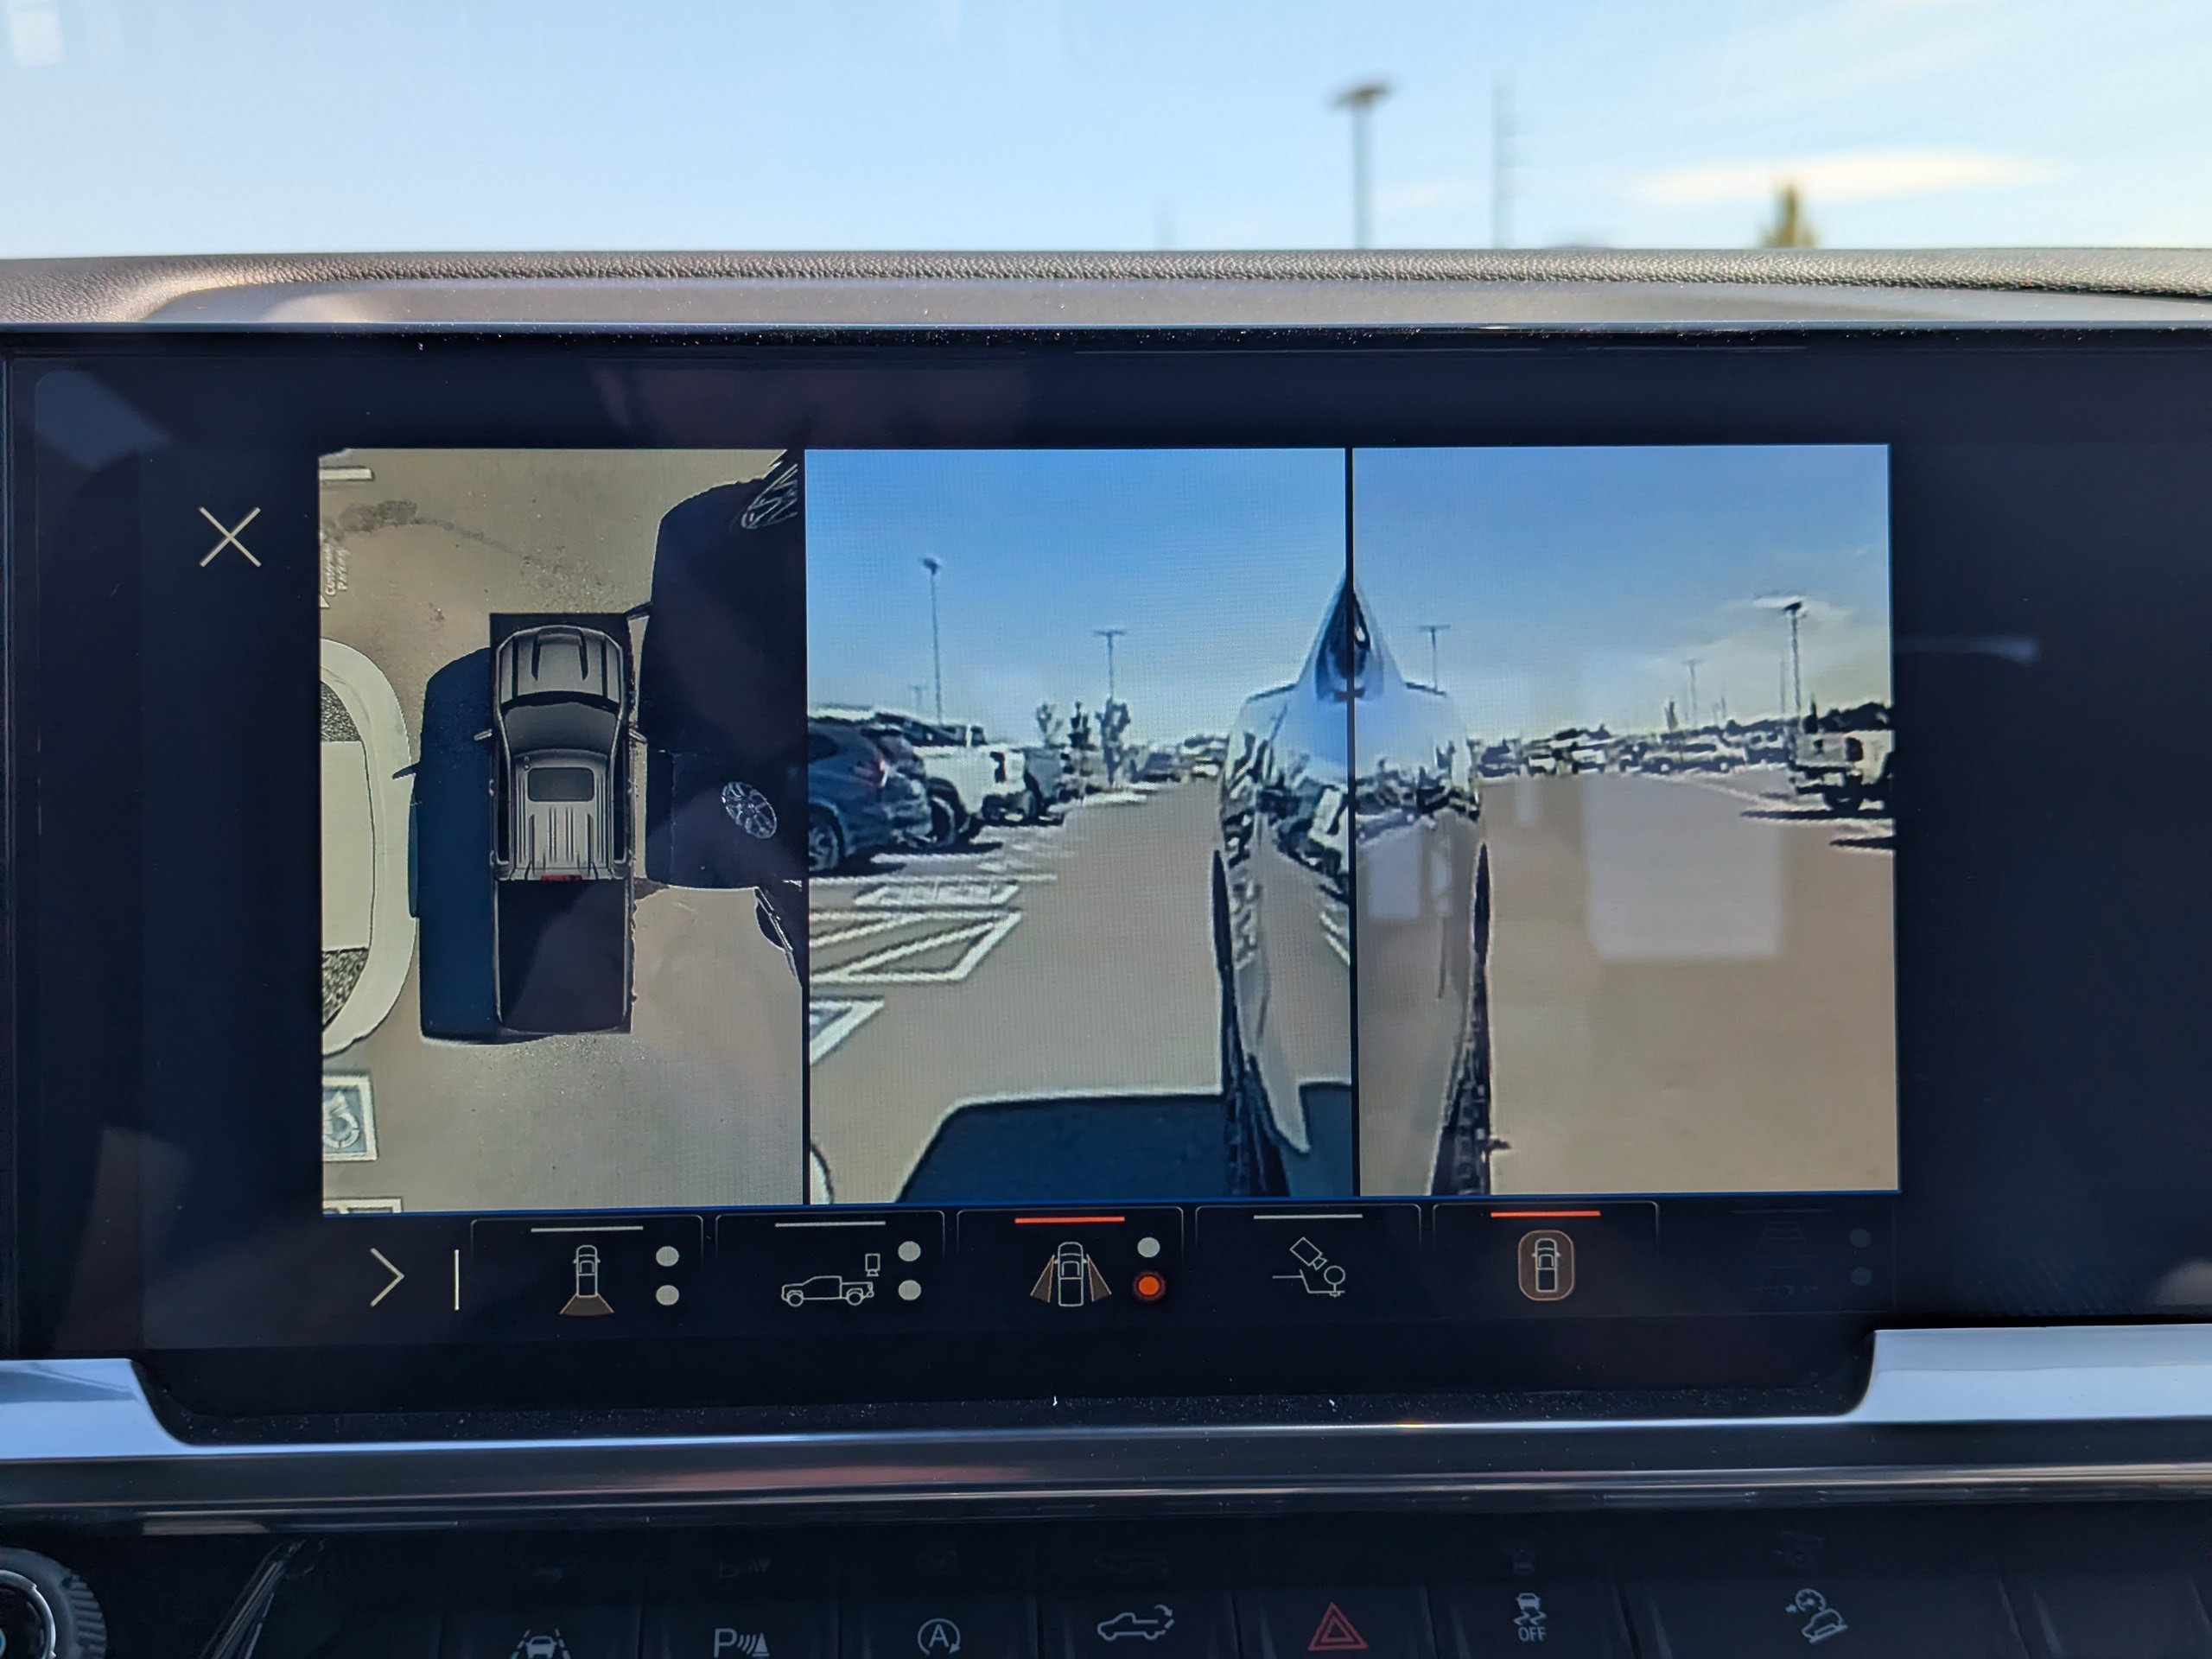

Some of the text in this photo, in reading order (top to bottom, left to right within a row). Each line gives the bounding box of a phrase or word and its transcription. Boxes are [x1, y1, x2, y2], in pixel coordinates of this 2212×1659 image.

[714, 1628, 737, 1658] P
[928, 1624, 950, 1648] A
[1517, 1625, 1547, 1643] OFF
